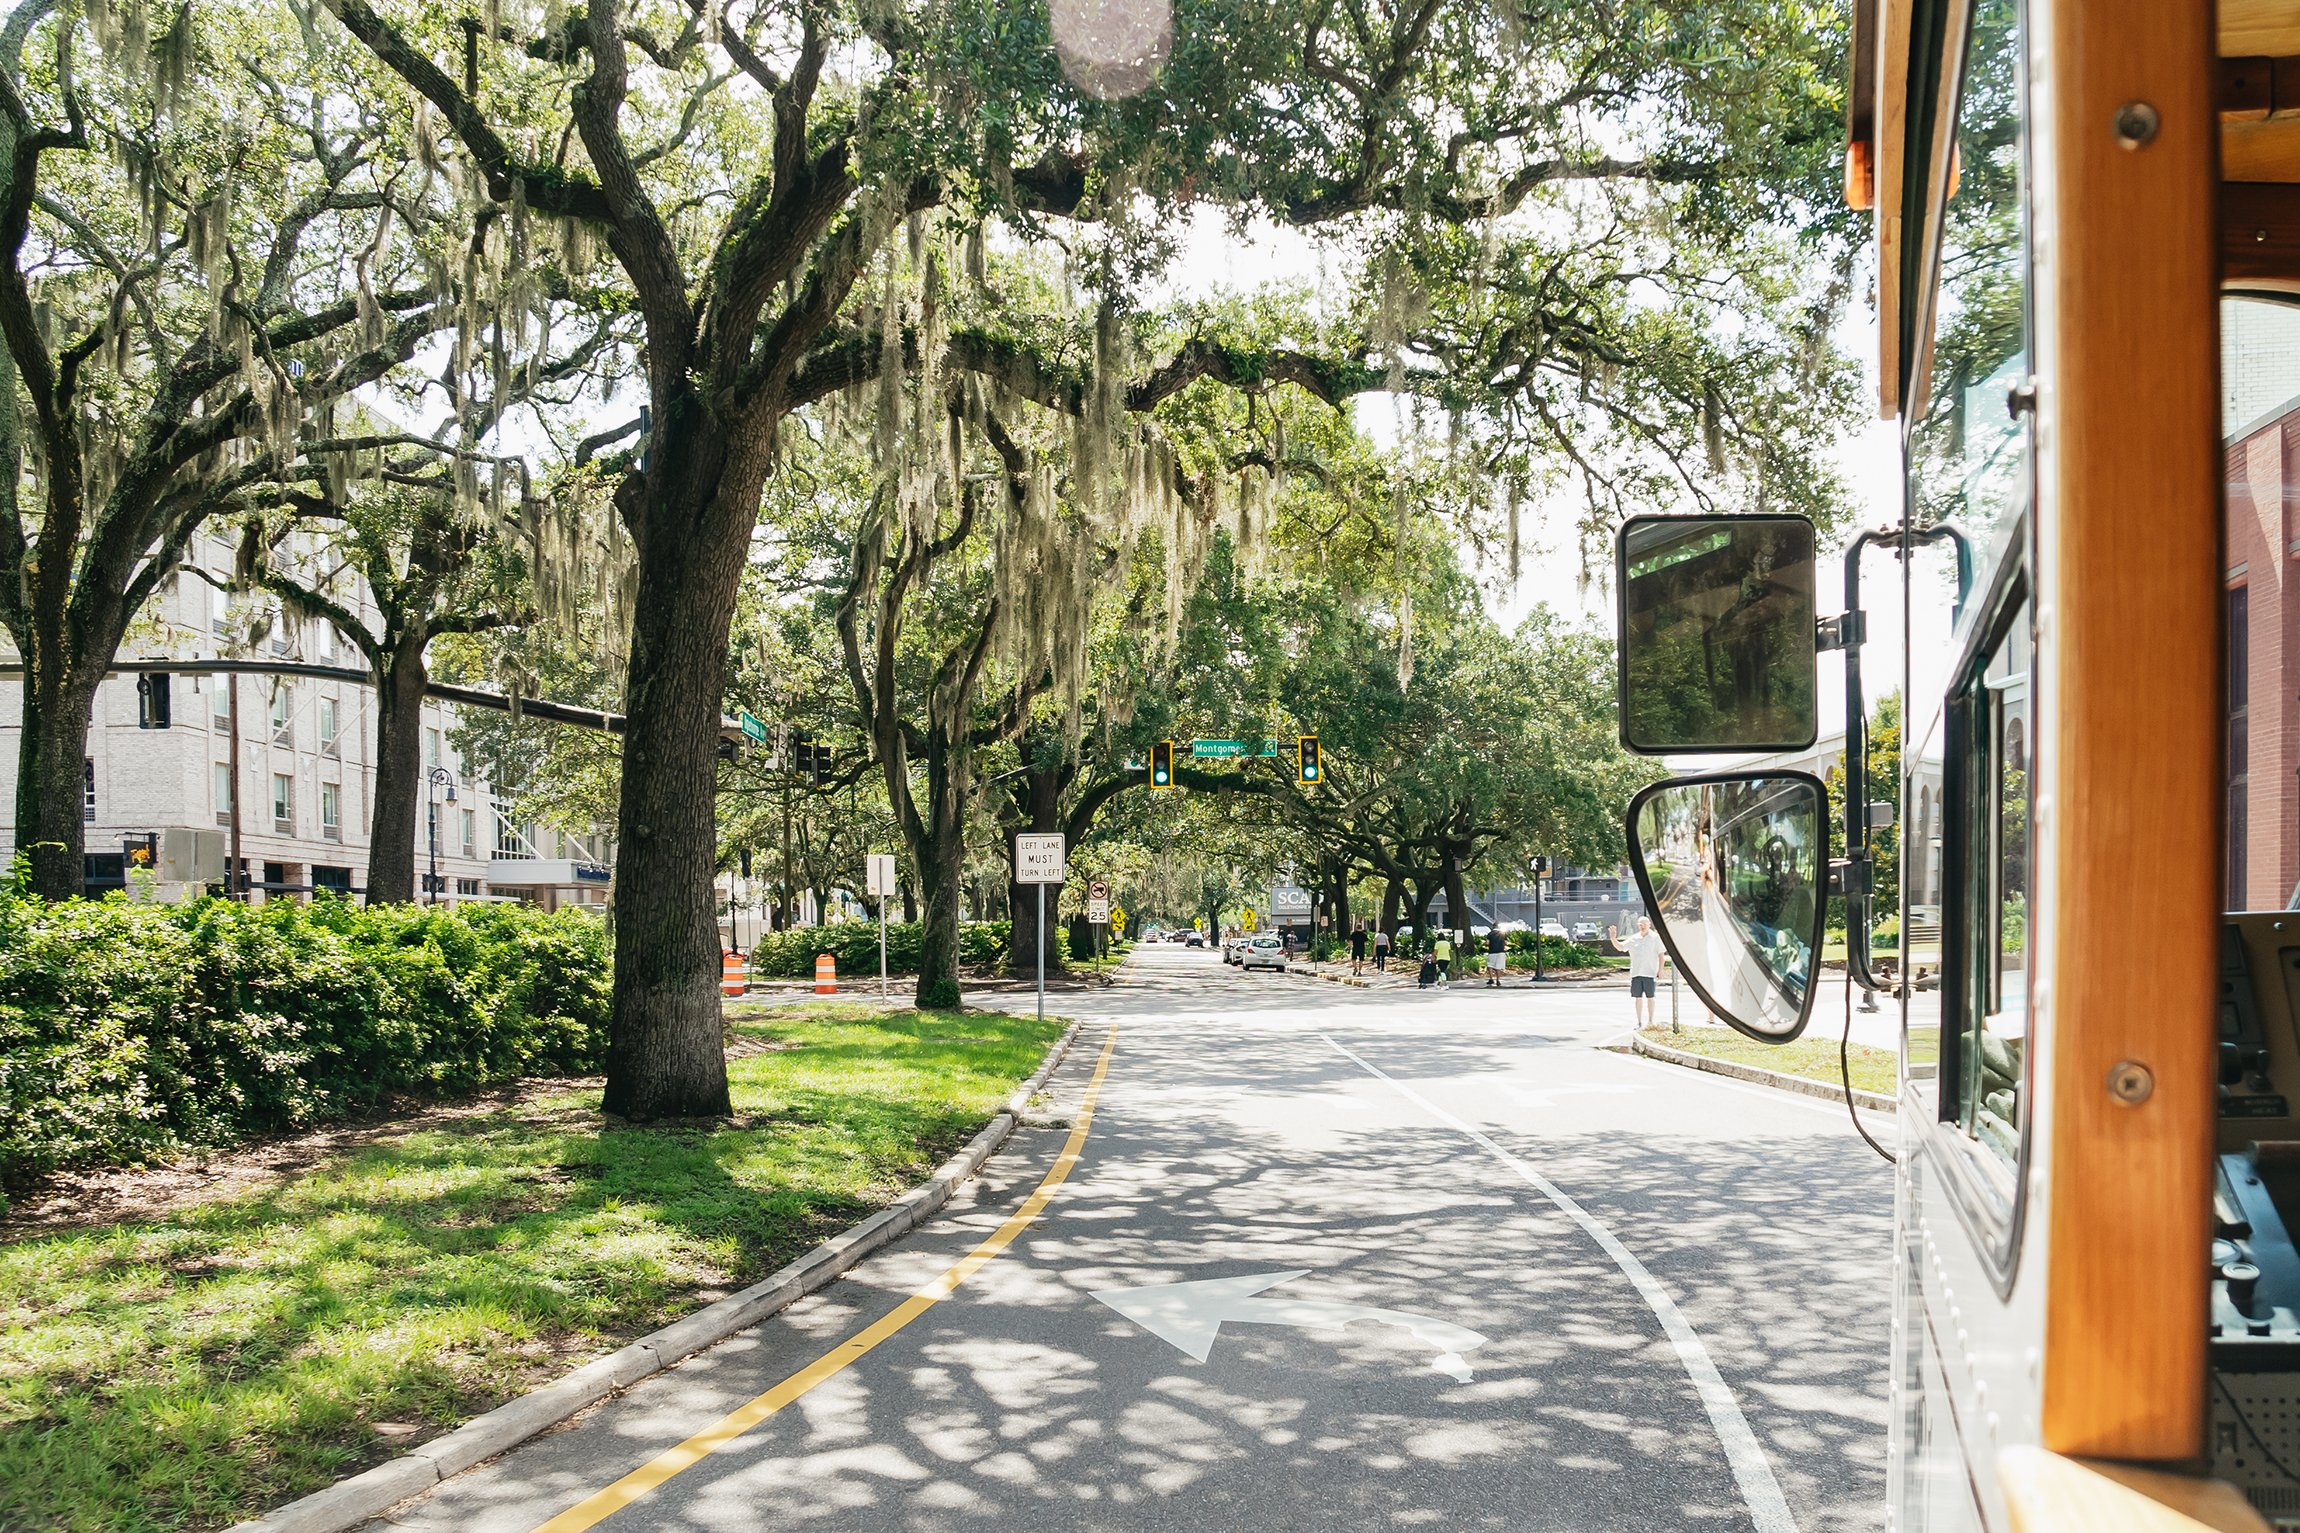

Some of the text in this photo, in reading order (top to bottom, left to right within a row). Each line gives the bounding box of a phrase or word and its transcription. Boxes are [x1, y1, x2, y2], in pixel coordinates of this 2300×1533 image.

[1021, 841, 1060, 850] LEFT LANE
[1028, 854, 1053, 864] MUST
[1021, 868, 1060, 877] TURN LEFT
[1090, 911, 1106, 920] 25
